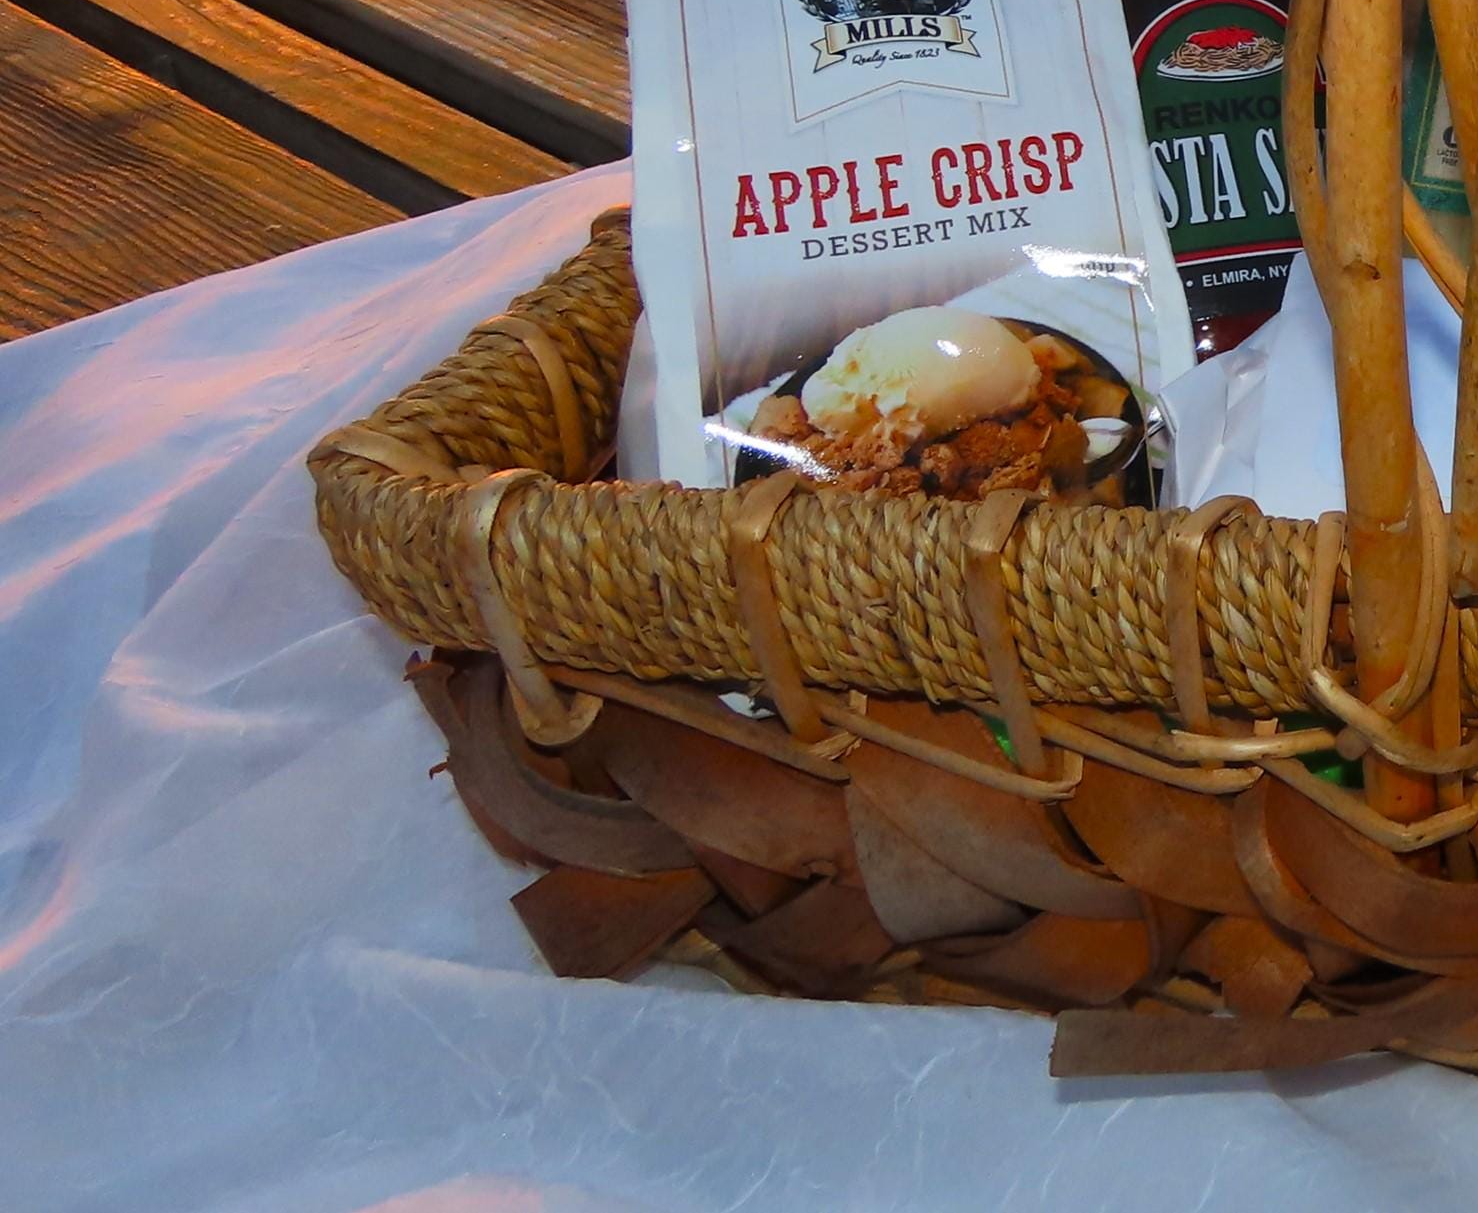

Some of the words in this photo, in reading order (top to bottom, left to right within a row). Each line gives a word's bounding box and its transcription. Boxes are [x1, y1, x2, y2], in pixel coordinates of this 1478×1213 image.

[846, 17, 941, 44] MILLS
[852, 49, 887, 68] Quality
[733, 154, 909, 238] APPLE
[931, 131, 1084, 208] CRISP
[1151, 133, 1246, 228] STA
[802, 219, 954, 260] DESSERT
[968, 206, 1032, 236] MIX
[1201, 270, 1266, 288] ELMIRA,
[1268, 265, 1289, 279] NY
